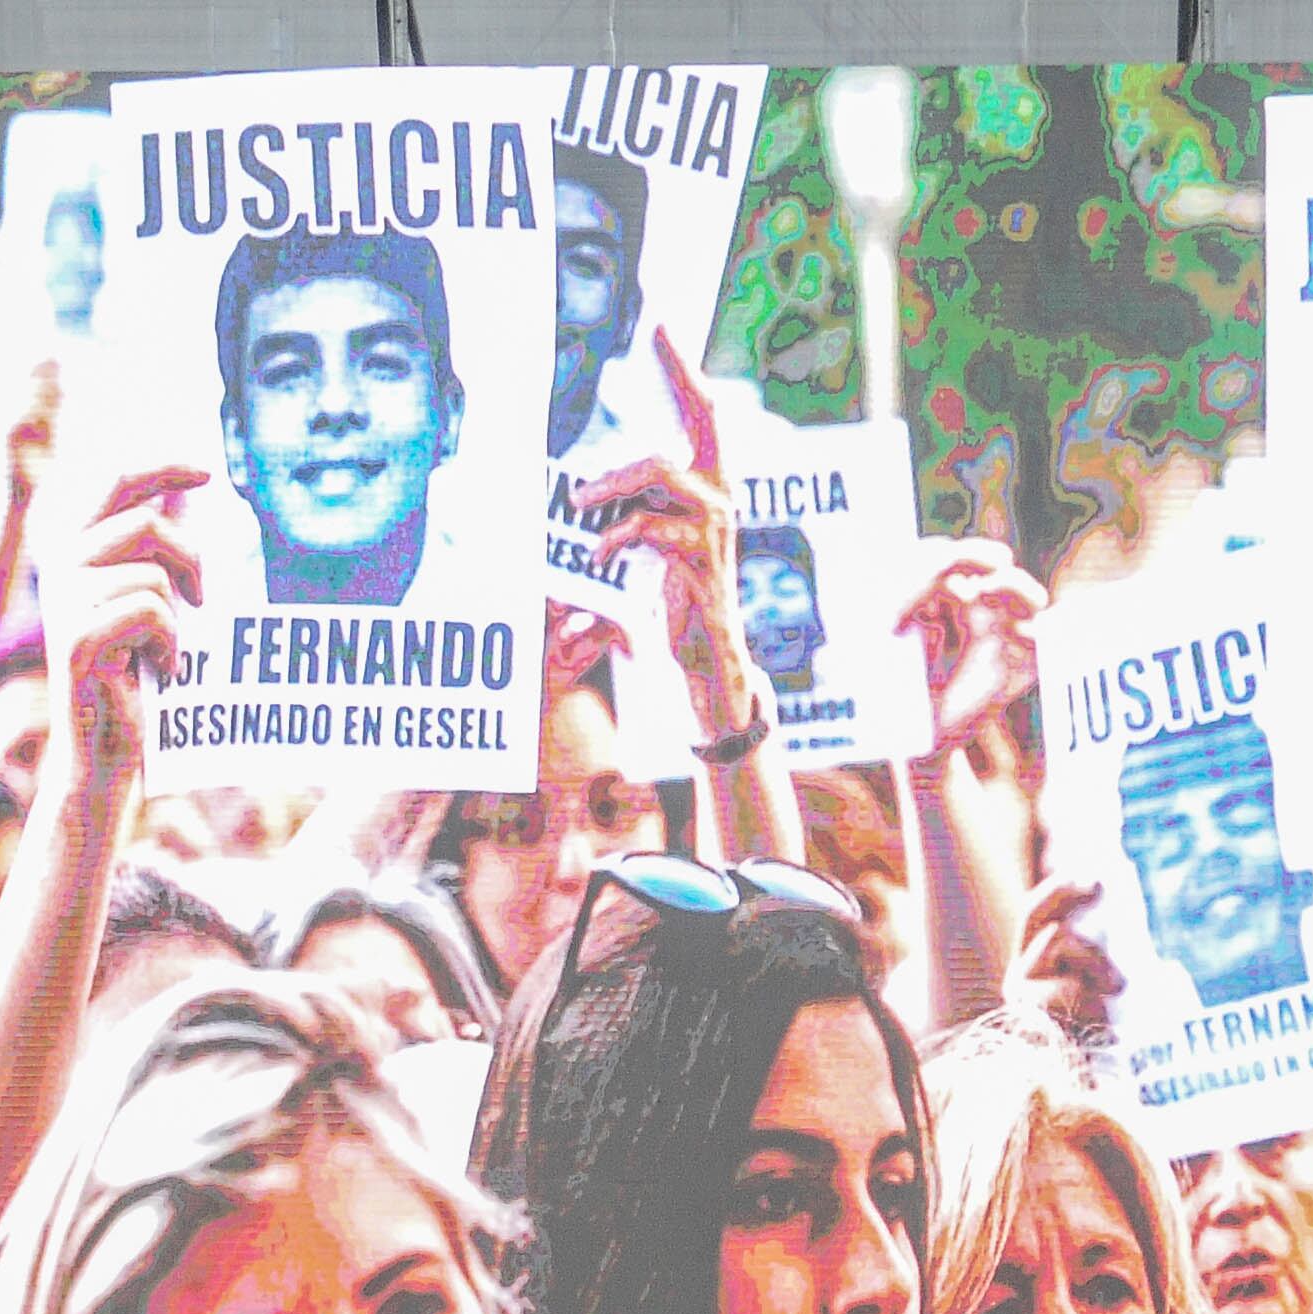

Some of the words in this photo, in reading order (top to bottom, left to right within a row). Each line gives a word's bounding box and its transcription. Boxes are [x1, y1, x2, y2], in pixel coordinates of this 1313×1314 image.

[136, 119, 538, 237] JUSTICIA
[230, 616, 514, 691] FERNANDO
[159, 703, 333, 751] ASESINADO
[344, 706, 382, 749] EN
[393, 708, 508, 752] GESELL
[1139, 1063, 1266, 1106] ASESINADO
